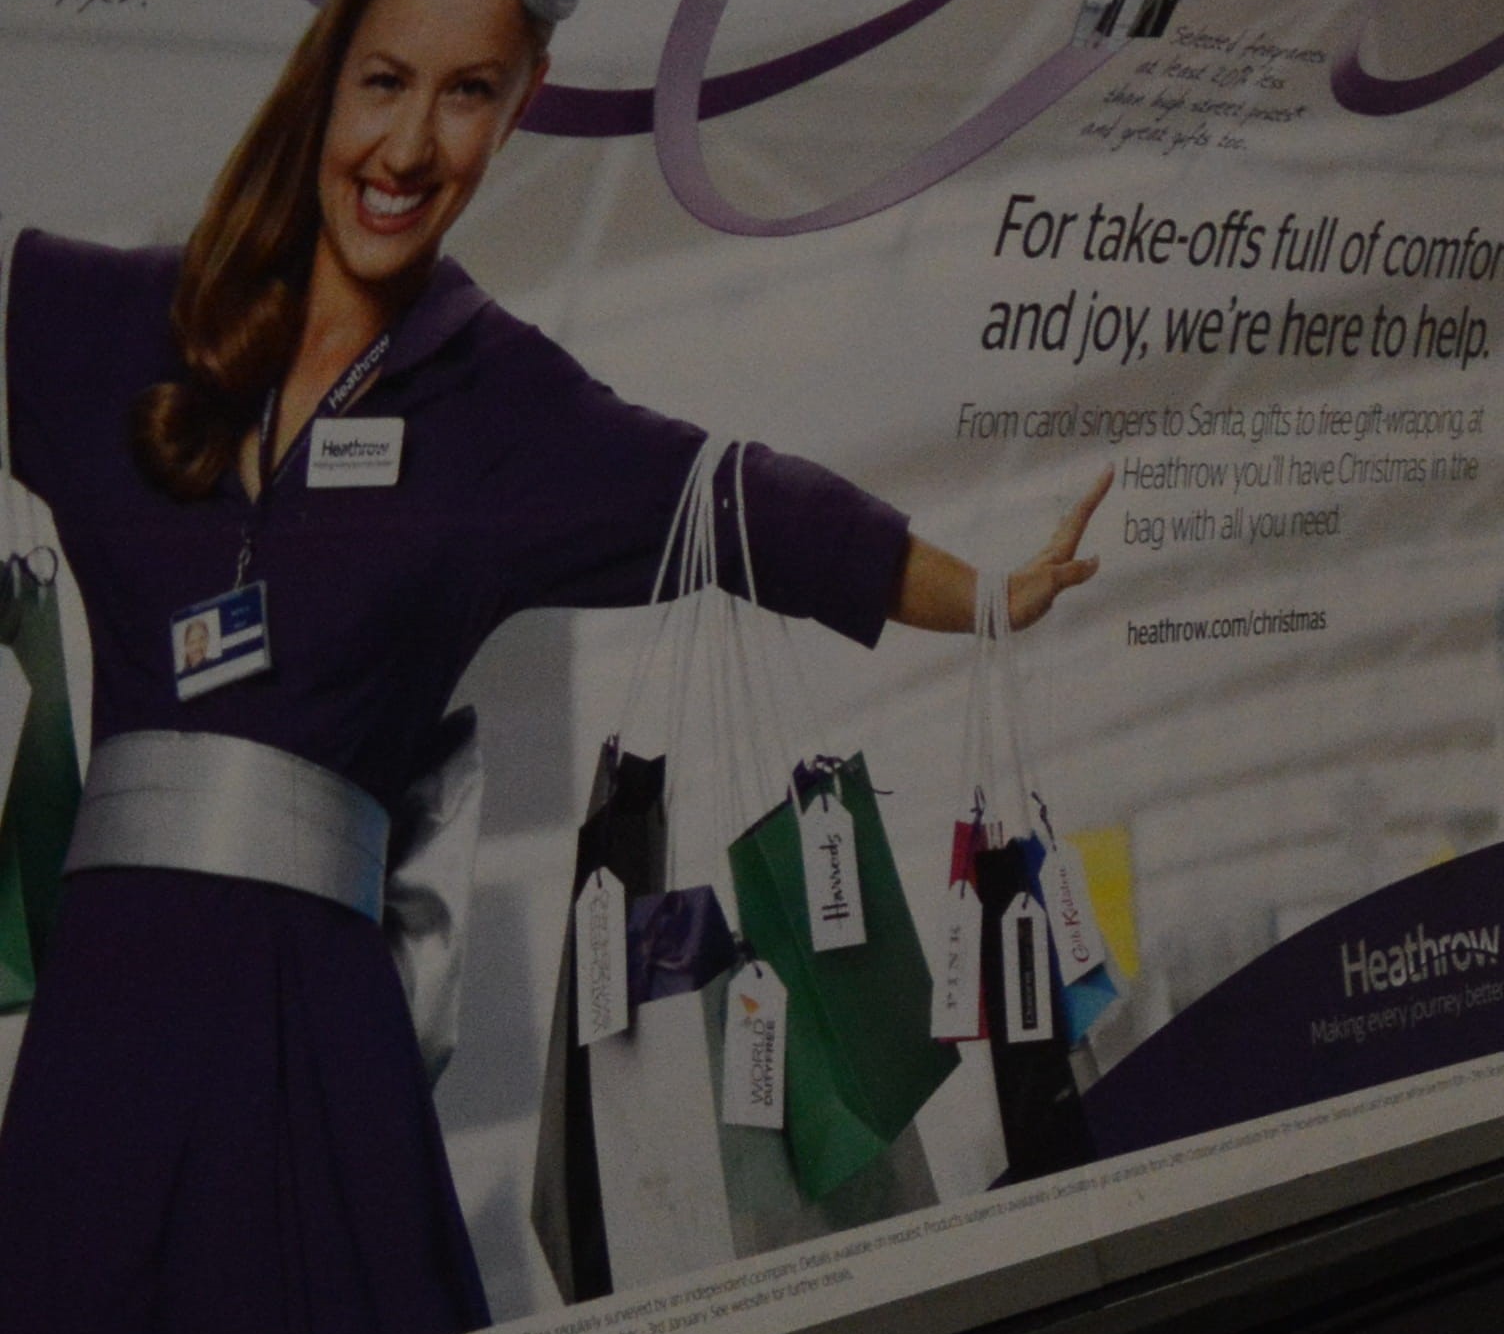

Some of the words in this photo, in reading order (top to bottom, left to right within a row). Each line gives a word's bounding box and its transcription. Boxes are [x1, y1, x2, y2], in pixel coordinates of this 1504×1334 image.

[1170, 24, 1248, 53] Selected
[1102, 81, 1146, 105] than
[1149, 87, 1192, 123] high
[1190, 97, 1248, 118] street
[1079, 114, 1124, 140] and
[1108, 125, 1170, 153] great
[1161, 121, 1211, 157] gifts
[992, 192, 1080, 260] For
[1081, 200, 1268, 269] take-offs
[1269, 211, 1339, 274] full
[1338, 216, 1387, 275] of
[979, 287, 1077, 352] and
[1072, 289, 1151, 367] joy,
[1163, 294, 1272, 357] we're
[1276, 298, 1364, 359] here
[1368, 303, 1409, 359] to
[1412, 302, 1492, 370] help.
[328, 332, 390, 411] Heathrow
[321, 437, 390, 459] Heathrow
[957, 402, 1019, 440] From
[1023, 402, 1077, 438] carol
[1080, 404, 1159, 444] singers
[1161, 406, 1185, 436] to
[1185, 402, 1247, 439] Santa,
[1249, 404, 1292, 442] gifts
[1295, 406, 1317, 435] to
[1317, 403, 1354, 437] free
[1465, 407, 1485, 436] at
[1120, 454, 1226, 491] Heathrow
[1231, 453, 1286, 495] you'll
[1288, 452, 1334, 487] have
[1337, 449, 1427, 485] Christmas
[1430, 452, 1448, 481] in
[1447, 451, 1480, 482] the
[1123, 508, 1165, 551] bag
[1171, 507, 1216, 544] with
[1220, 505, 1244, 540] all
[1246, 510, 1287, 548] you
[1290, 504, 1342, 539] need.
[1125, 606, 1329, 648] heathrow.com/christmas
[819, 832, 850, 921] Harrods
[947, 925, 961, 1009] PINK
[1341, 922, 1501, 998] Heathrow
[1311, 1014, 1366, 1045] Making
[1367, 1006, 1409, 1032] every
[1409, 994, 1463, 1028] journey
[1464, 980, 1504, 1008] better
[750, 1017, 767, 1106] WORLD
